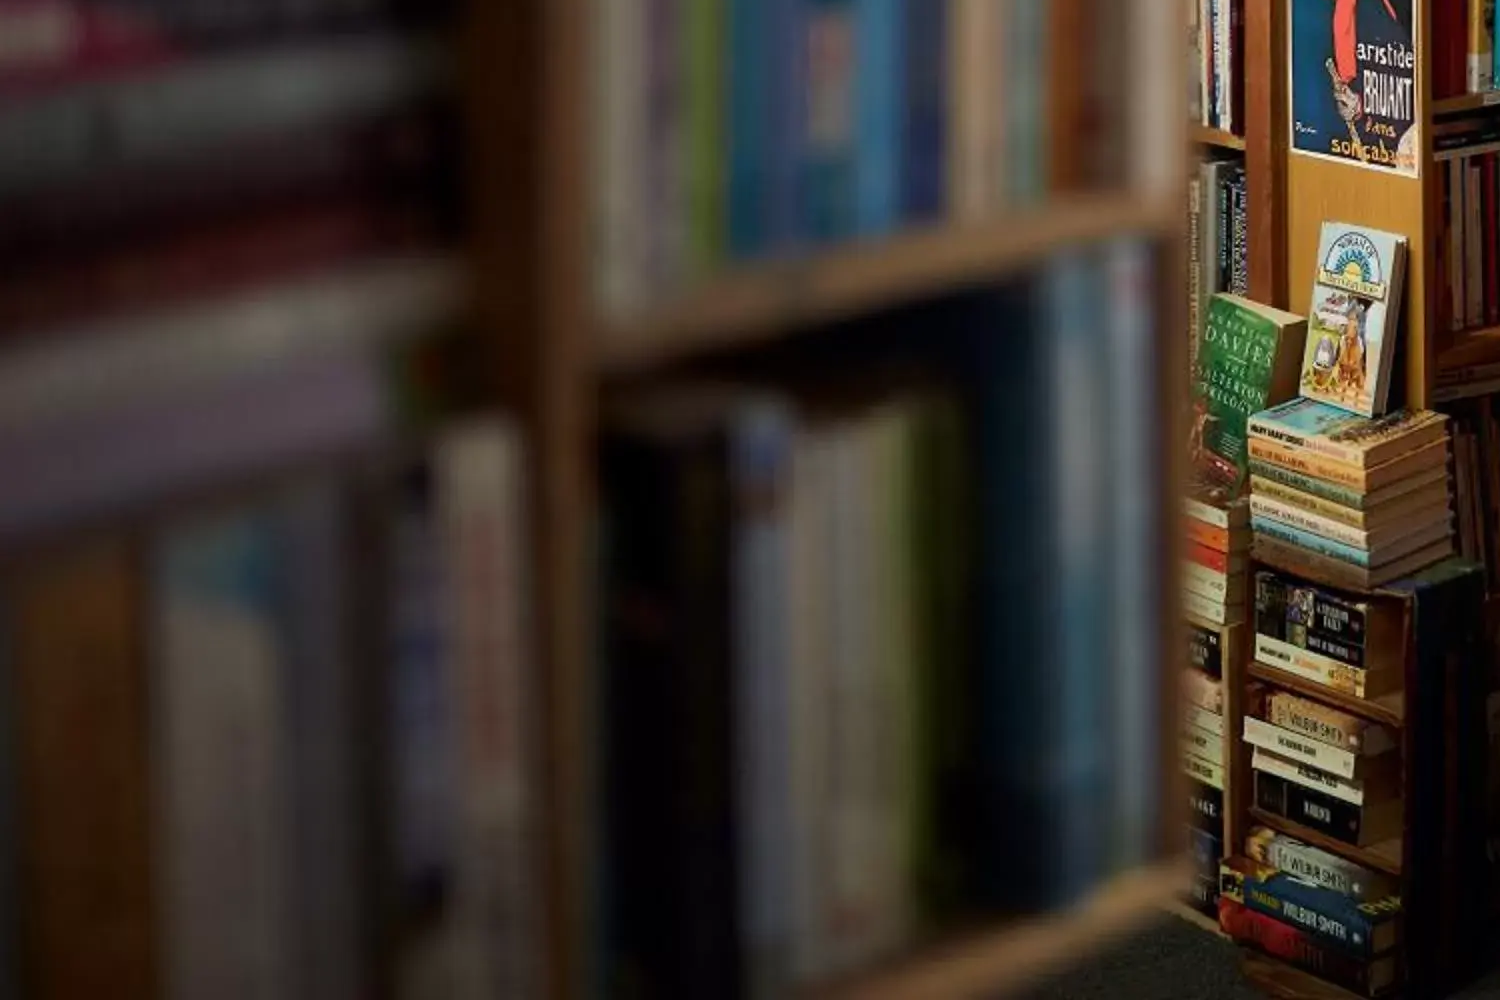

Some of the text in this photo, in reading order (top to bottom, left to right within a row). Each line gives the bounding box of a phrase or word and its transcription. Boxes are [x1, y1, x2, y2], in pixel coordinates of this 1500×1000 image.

[1357, 41, 1414, 70] aristide
[1364, 69, 1413, 121] BRUANT
[1204, 324, 1274, 368] DAVIES
[1224, 358, 1247, 378] THE
[1199, 381, 1253, 416] TRILOGY
[1290, 857, 1350, 892] WILBUR SMITH
[1281, 900, 1348, 941] WILBUR SMITH
